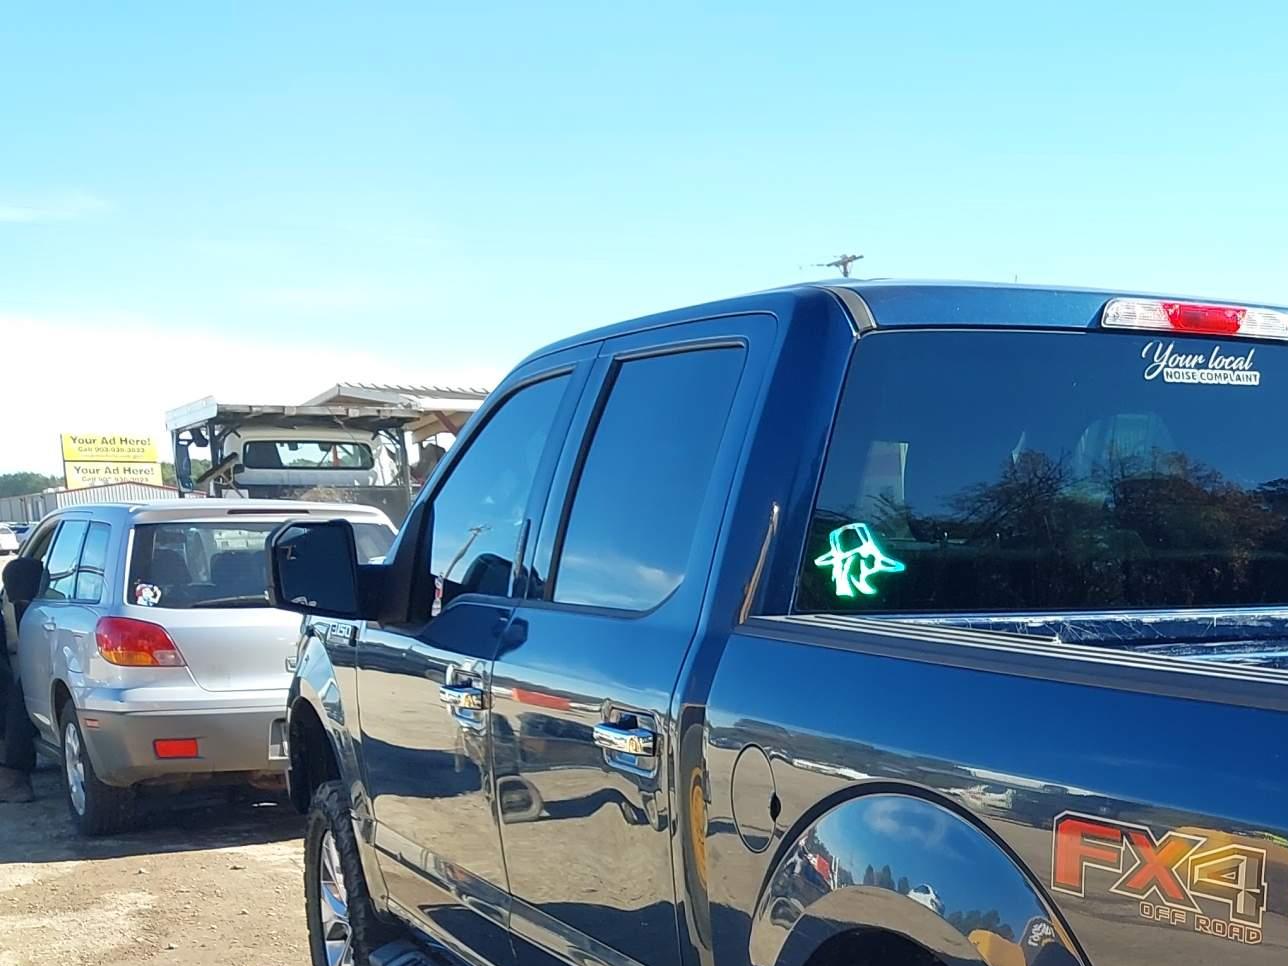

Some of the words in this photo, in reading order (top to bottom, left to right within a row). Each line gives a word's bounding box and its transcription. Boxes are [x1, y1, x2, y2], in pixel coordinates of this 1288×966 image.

[1141, 340, 1206, 380] Your
[1208, 346, 1255, 371] local
[1165, 370, 1197, 381] NOISE
[1199, 371, 1259, 383] COMPLAINT
[70, 435, 97, 445] Your
[100, 436, 116, 445] Ad
[119, 437, 151, 446] Here!
[74, 466, 101, 475] Your
[104, 466, 120, 475] Ad
[123, 467, 155, 475] Here!
[1051, 810, 1267, 927] FX4
[1139, 900, 1187, 925] OFF
[1194, 914, 1263, 945] ROAD
